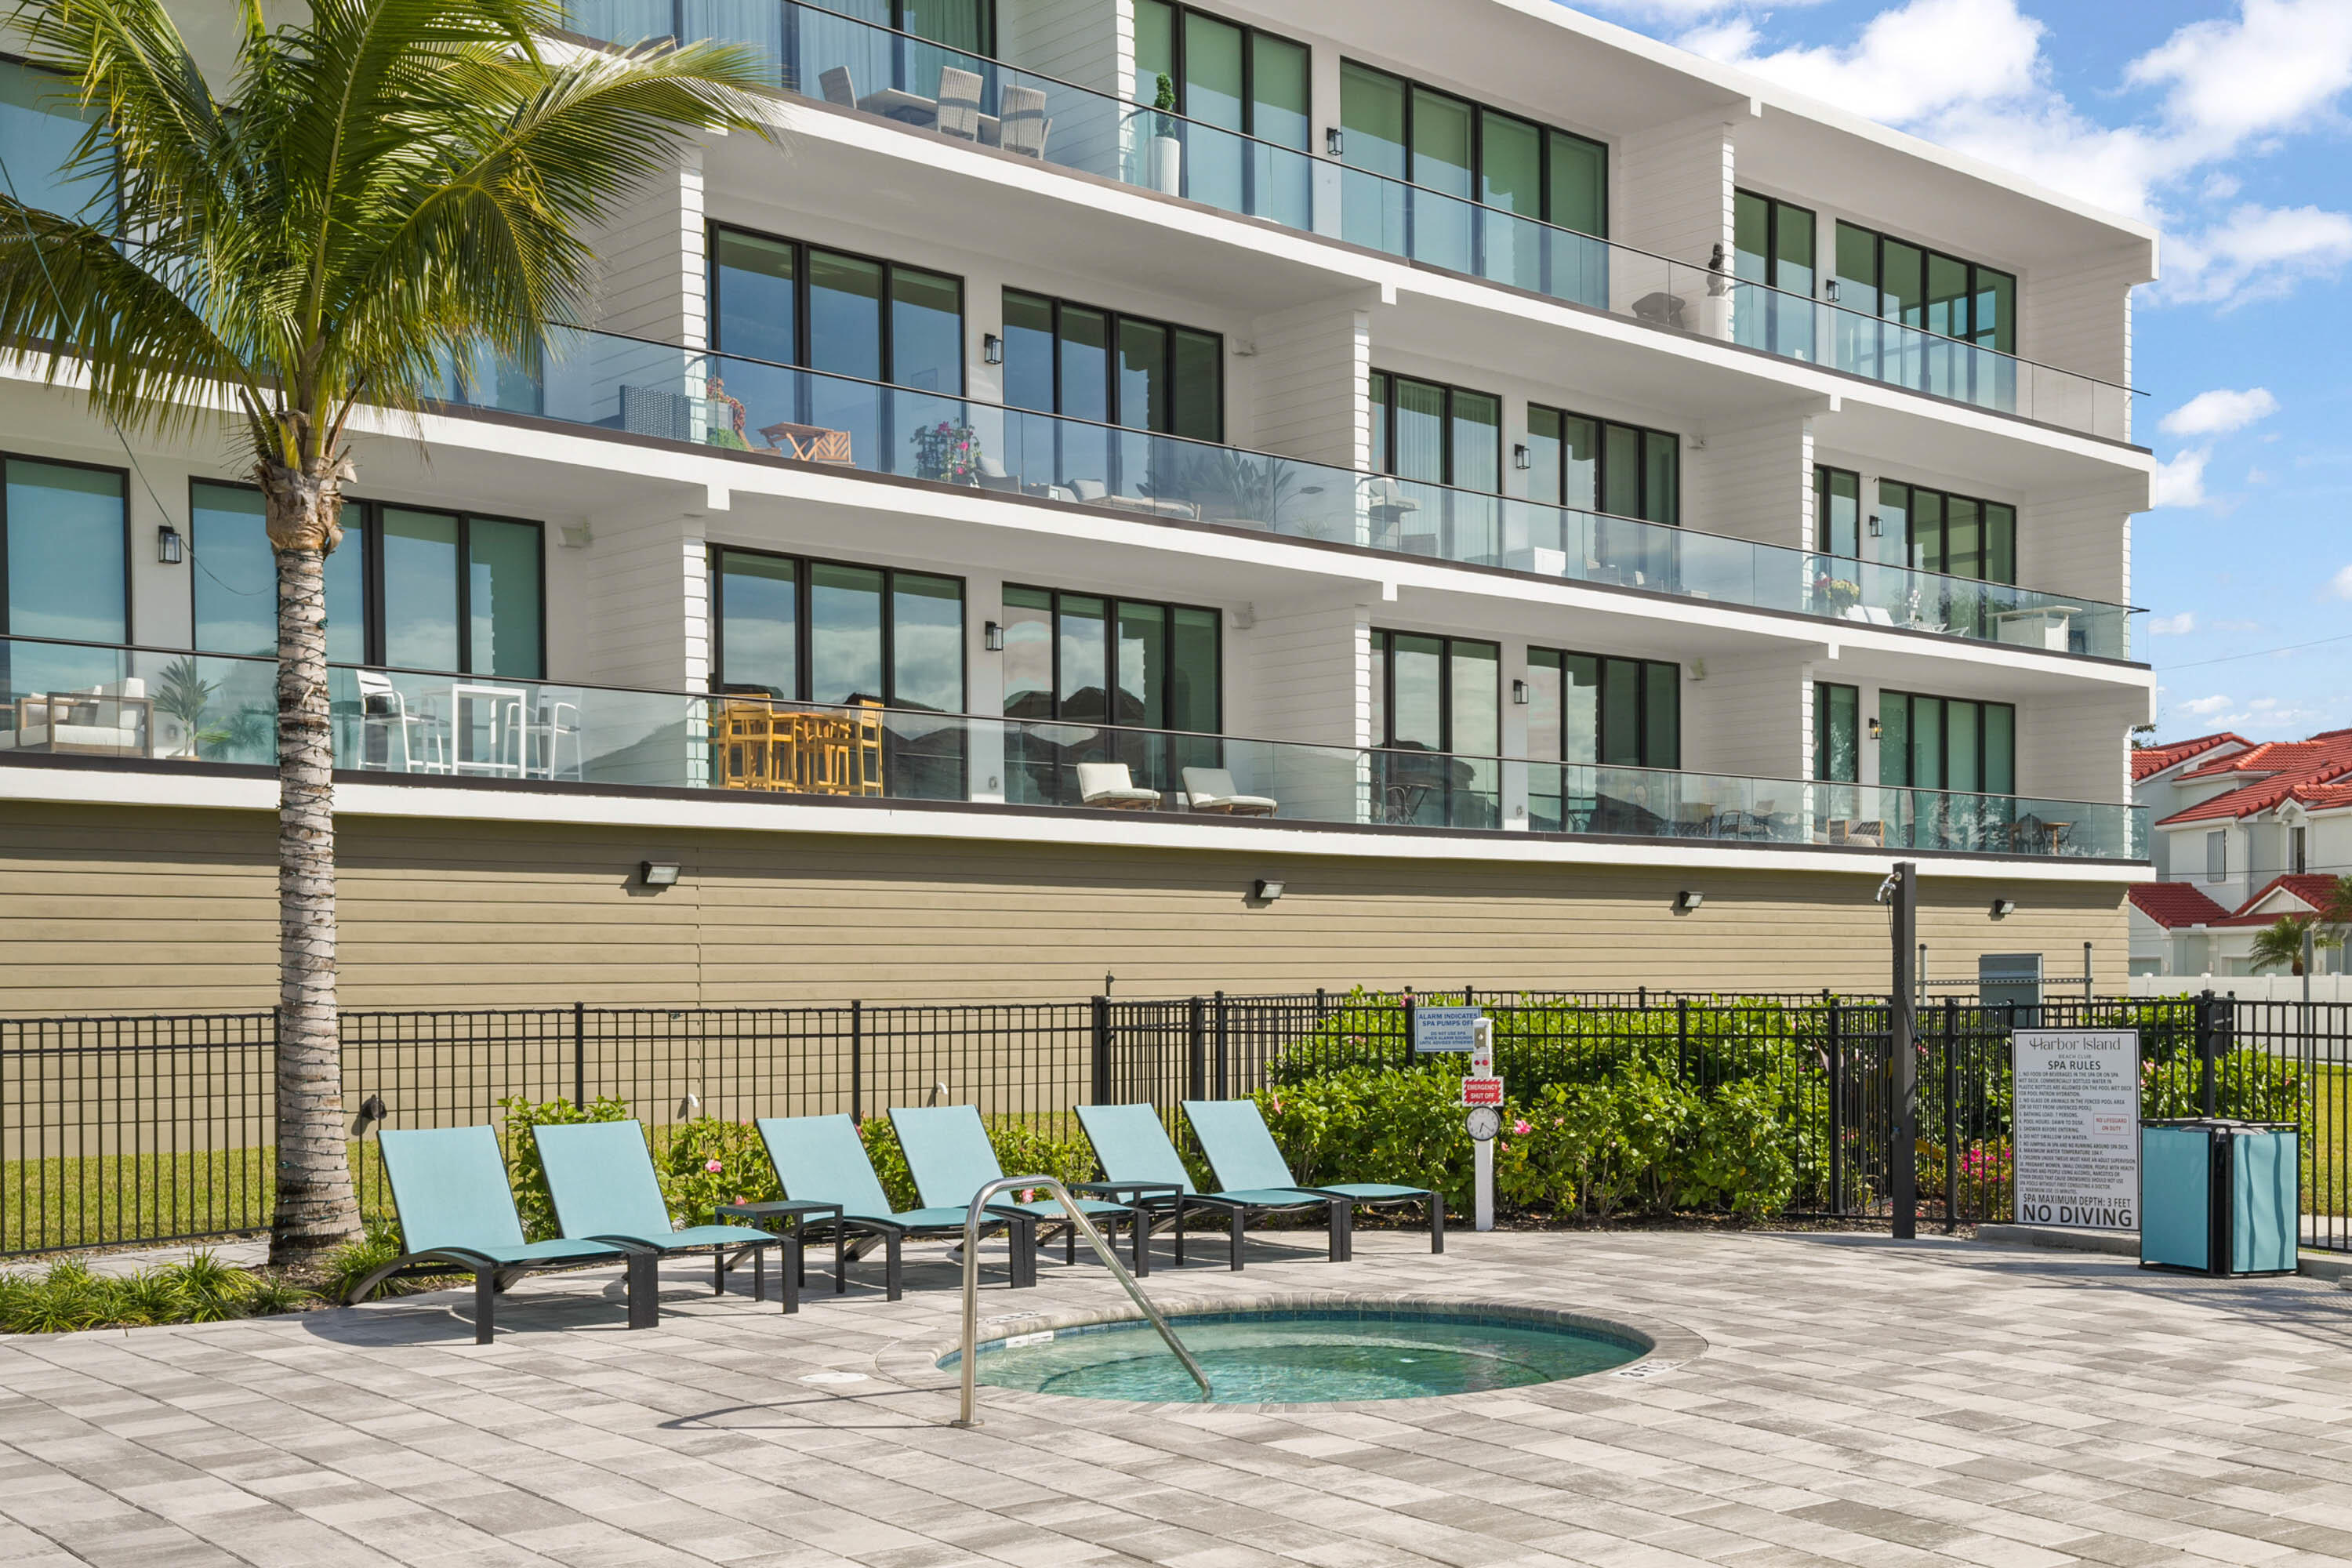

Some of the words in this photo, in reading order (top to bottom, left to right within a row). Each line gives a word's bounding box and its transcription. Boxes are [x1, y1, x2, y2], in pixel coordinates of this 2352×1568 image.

[2029, 1037, 2080, 1050] Harbor
[2083, 1037, 2120, 1050] Island
[2048, 1060, 2066, 1070] SPA
[2070, 1061, 2101, 1070] RULES
[2023, 1193, 2036, 1203] SPA
[2038, 1194, 2077, 1205] MAXIMUM
[2079, 1196, 2106, 1206] DEPTH:
[2107, 1197, 2112, 1207] 3
[2114, 1197, 2131, 1208] FEET
[2023, 1204, 2051, 1223] NO
[2060, 1206, 2132, 1227] DIVING
